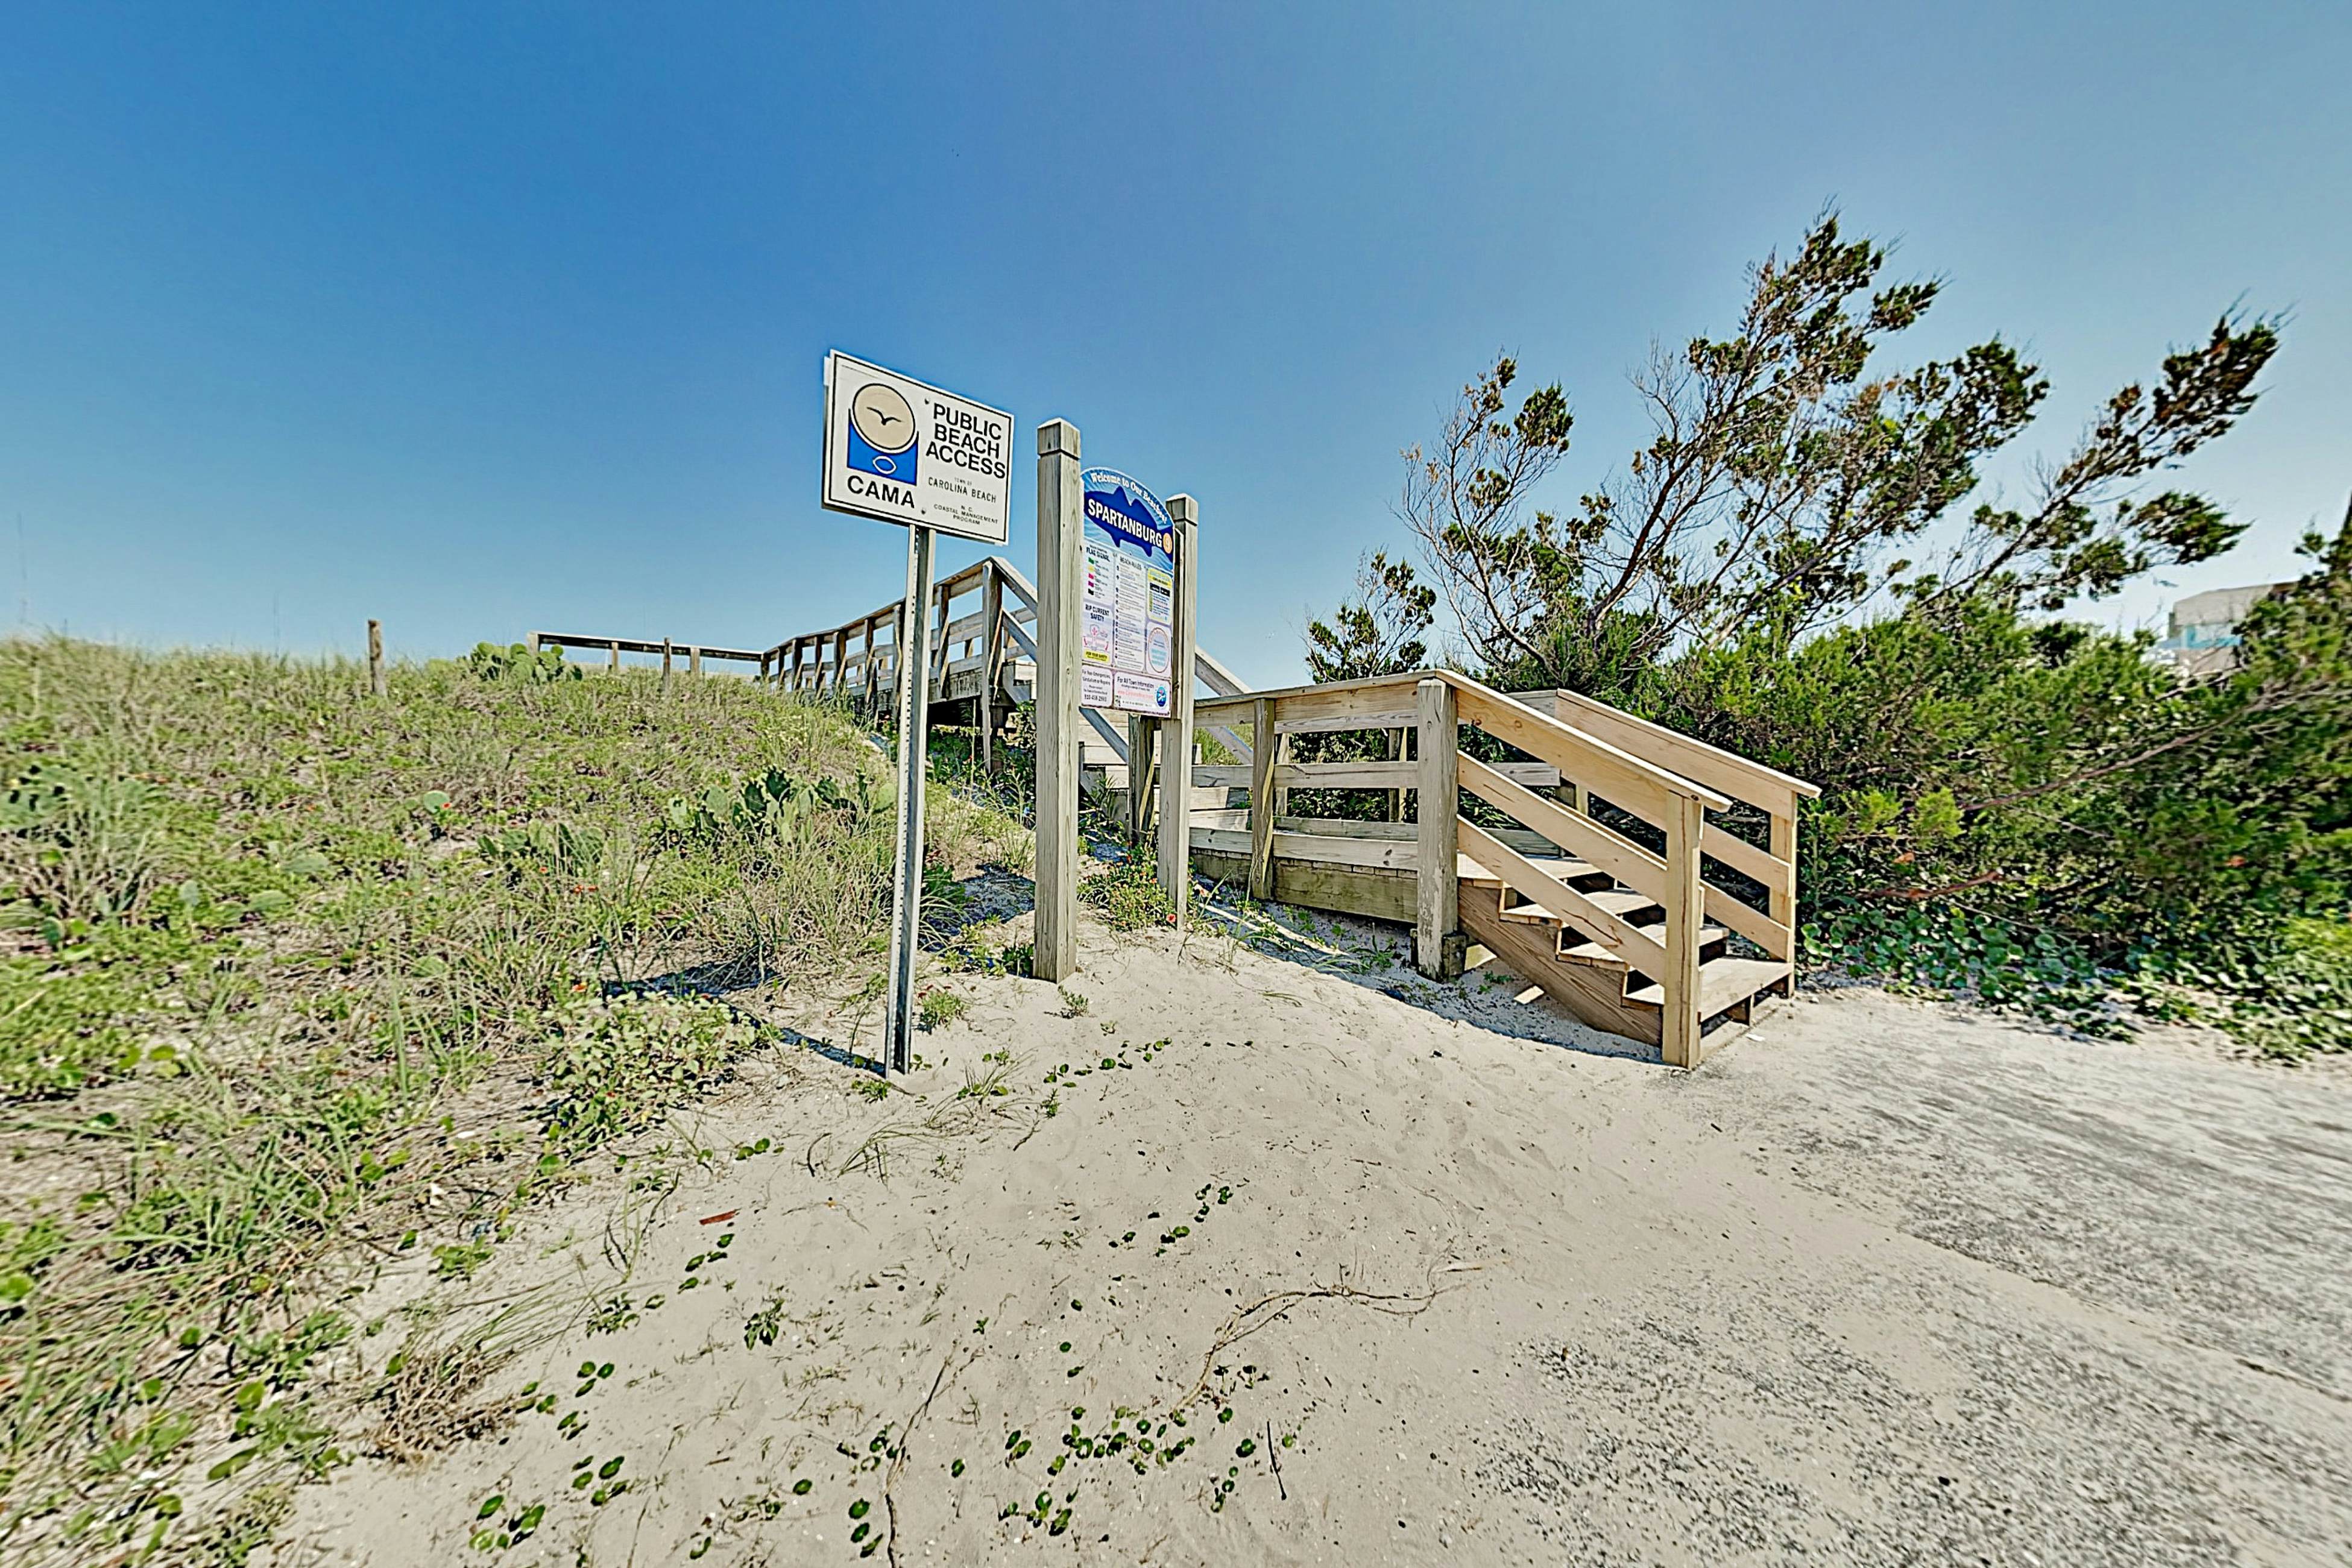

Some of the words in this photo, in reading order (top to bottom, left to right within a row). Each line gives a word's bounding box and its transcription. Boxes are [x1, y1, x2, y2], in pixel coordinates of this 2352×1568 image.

[934, 403, 1001, 440] PUBLIC
[935, 423, 1000, 459] BEACH
[926, 442, 1006, 479] ACCESS
[847, 475, 915, 508] CAMA
[929, 477, 967, 496] CAROLINA
[971, 488, 996, 503] BEACH
[1091, 472, 1121, 484] Welcome
[1122, 477, 1129, 488] to
[1130, 481, 1143, 496] Our
[934, 504, 957, 514] COASTAL
[961, 511, 998, 524] MANAGEMENT
[953, 514, 980, 524] PROGRAM
[1088, 499, 1162, 547] SPARTANBURG
[1091, 612, 1104, 622] SAFETY
[1092, 606, 1109, 616] CURRENT
